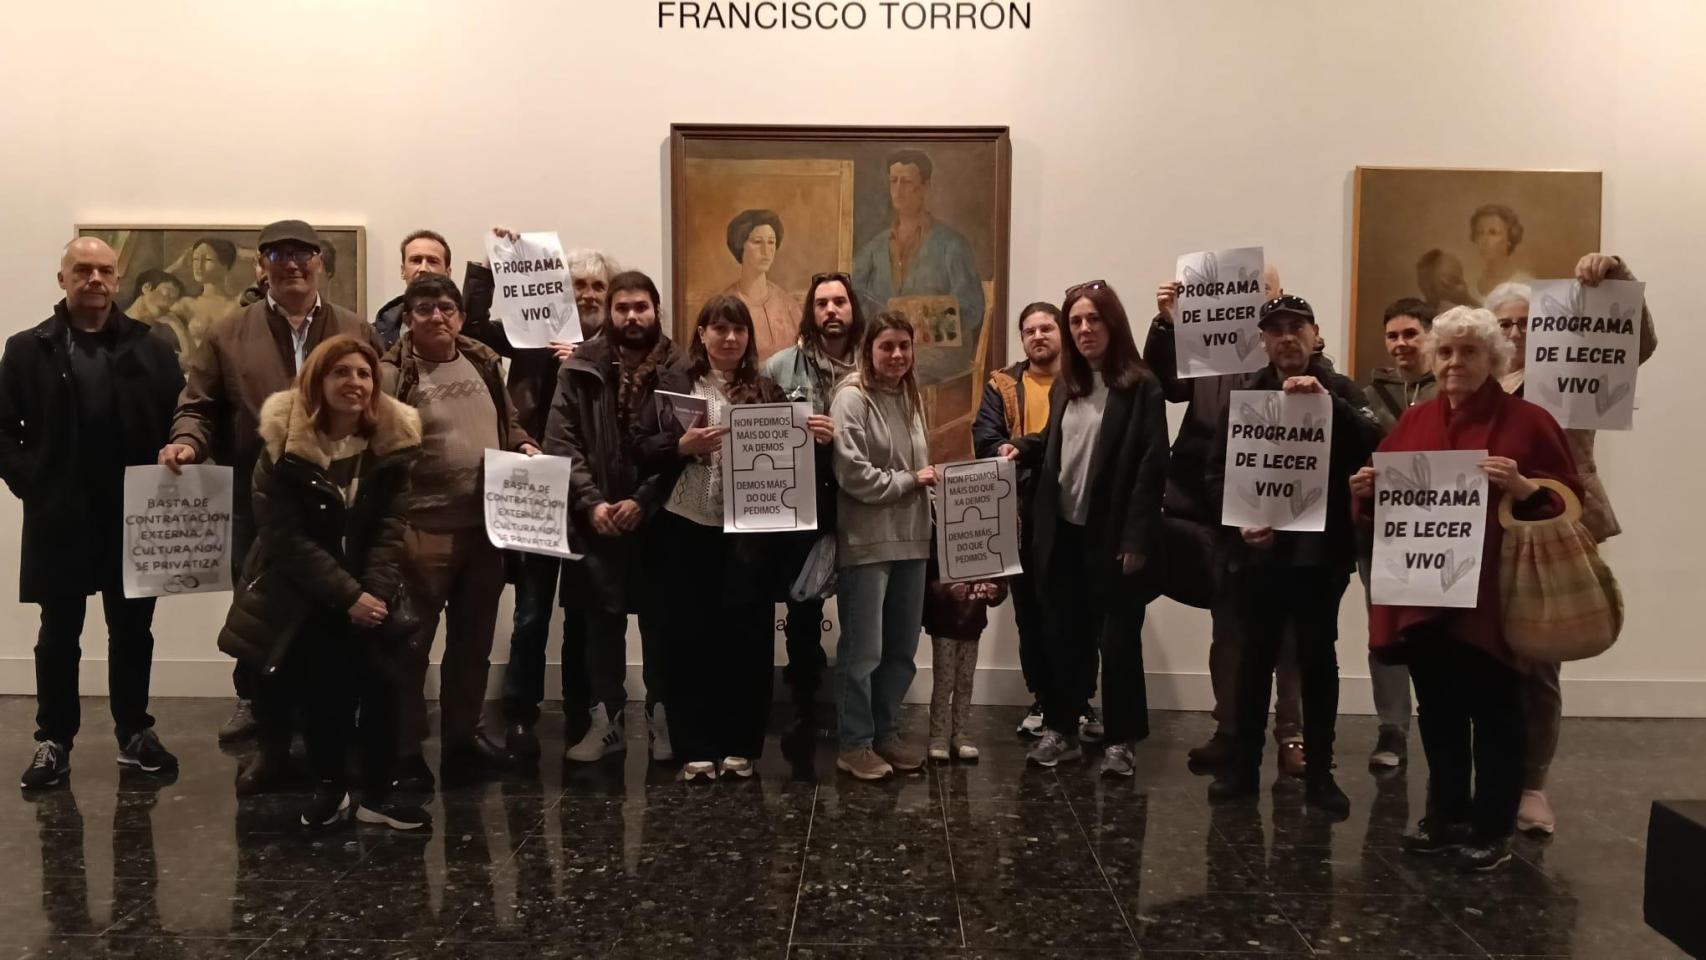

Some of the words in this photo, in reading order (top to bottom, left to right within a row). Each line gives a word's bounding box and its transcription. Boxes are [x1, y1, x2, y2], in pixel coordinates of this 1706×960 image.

[657, 1, 867, 30] FRANCISCO
[494, 258, 564, 274] PROGRAMA
[502, 285, 518, 298] DE
[521, 281, 564, 297] LECER
[1177, 280, 1260, 298] PROGRAMA
[521, 306, 551, 321] VIVO
[1182, 310, 1201, 324] DE
[1207, 306, 1255, 322] LECER
[1531, 316, 1634, 335] PROGRAMA
[1203, 332, 1238, 346] VIVO
[1536, 346, 1559, 362] DE
[1566, 346, 1626, 364] LECER
[1557, 377, 1600, 394] VIVO
[734, 419, 752, 427] NON
[754, 417, 790, 426] PEDIMOS
[758, 431, 770, 439] DO
[772, 430, 789, 439] QUE
[1232, 424, 1325, 442] PROGRAMA
[742, 444, 754, 452] XA
[755, 443, 784, 452] DEMOS
[1235, 452, 1257, 467] DE
[1263, 453, 1317, 470] LECER
[948, 475, 964, 484] NON
[965, 471, 997, 482] PEDIMOS
[503, 479, 536, 491] BASTA
[538, 485, 551, 494] DE
[737, 481, 765, 490] DEMOS
[969, 485, 979, 494] DO
[980, 483, 995, 493] QUE
[1255, 481, 1294, 497] VIVO
[147, 499, 189, 508] BASTA
[194, 498, 208, 507] DE
[746, 494, 758, 502] DO
[760, 493, 776, 502] QUE
[965, 495, 990, 505] DEMOS
[1379, 489, 1481, 506] PROGRAMA
[744, 506, 780, 515] PEDIMOS
[205, 529, 214, 537] A
[494, 521, 536, 532] CULTURA
[539, 527, 560, 535] NON
[1384, 521, 1407, 537] DE
[1414, 521, 1472, 537] LECER
[497, 534, 508, 542] SE
[510, 535, 560, 547] PRIVATIZA
[948, 531, 973, 541] DEMOS
[132, 545, 191, 556] CULTURA
[194, 544, 222, 553] NON
[957, 543, 968, 552] DO
[969, 541, 983, 550] QUE
[135, 562, 148, 571] SE
[153, 559, 219, 570] PRIVATIZA
[956, 553, 987, 563] PEDIMOS
[1405, 553, 1446, 569] VIVO
